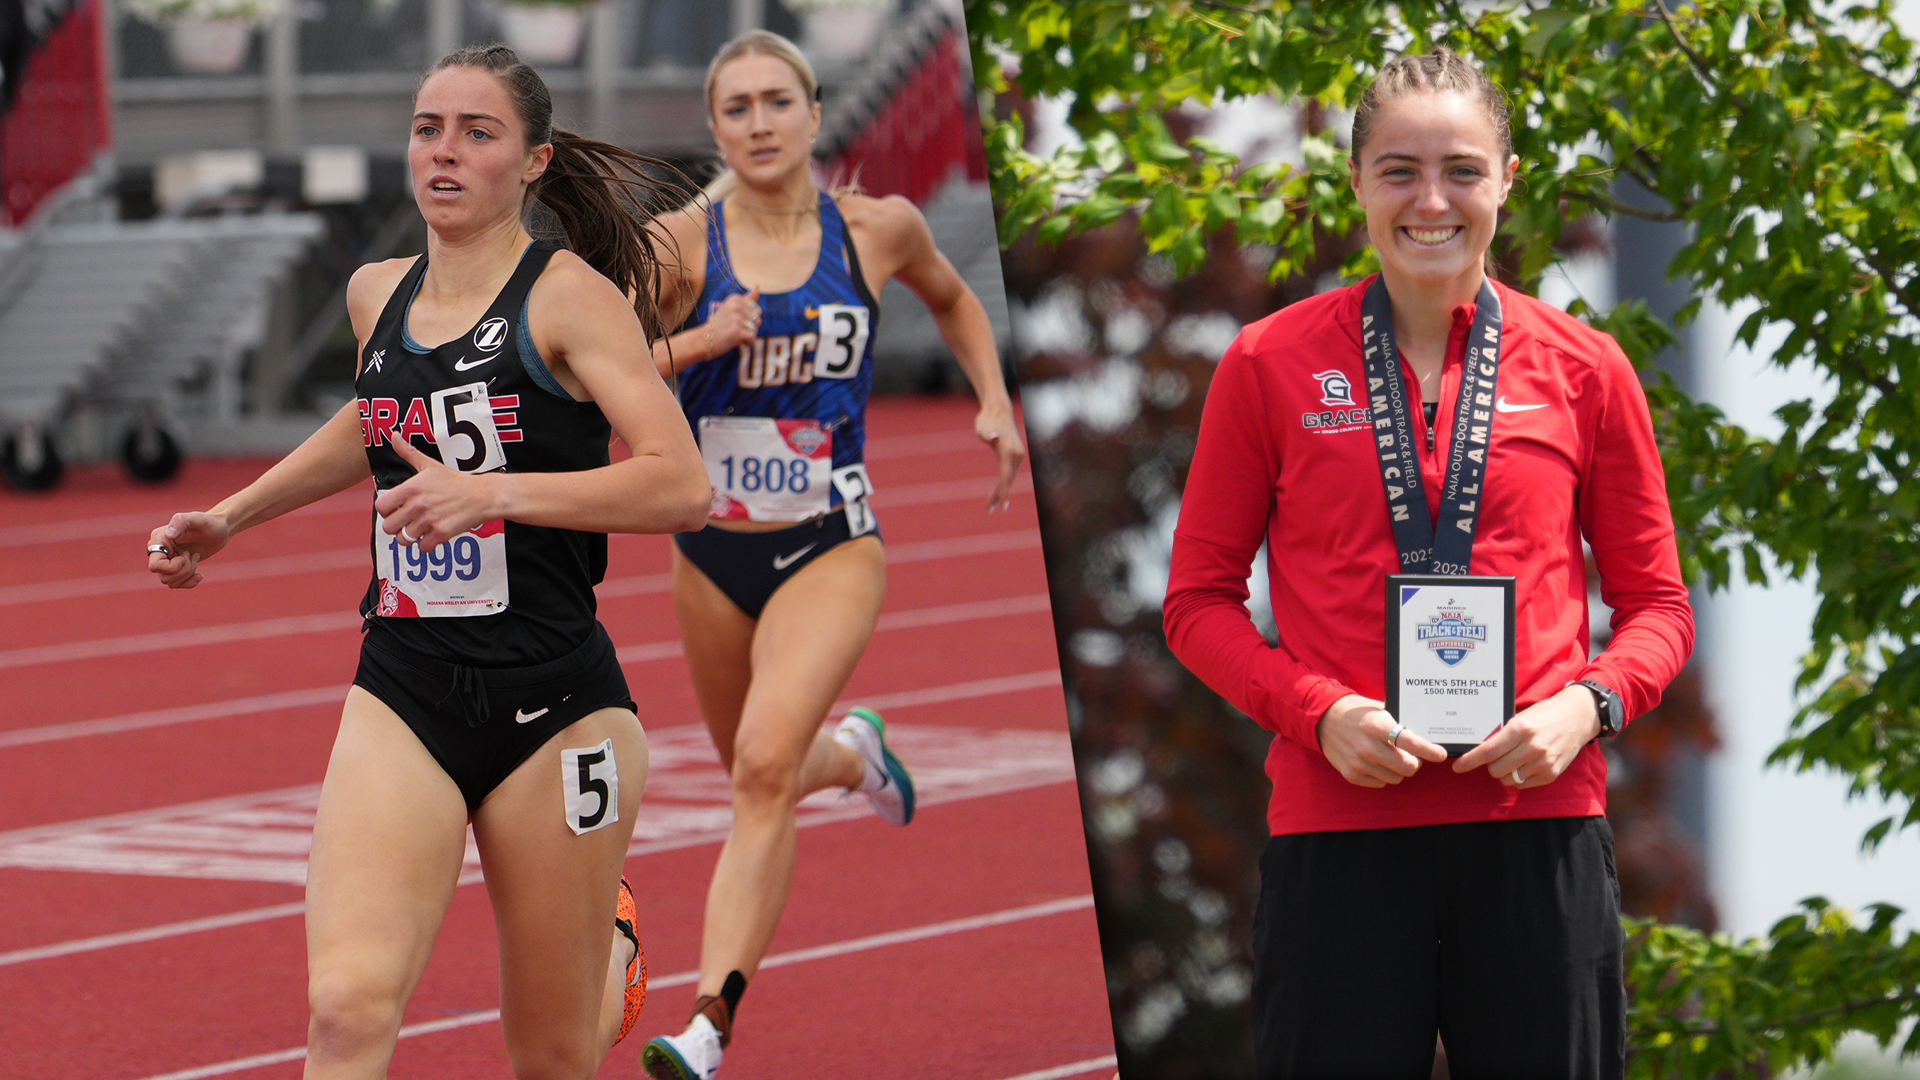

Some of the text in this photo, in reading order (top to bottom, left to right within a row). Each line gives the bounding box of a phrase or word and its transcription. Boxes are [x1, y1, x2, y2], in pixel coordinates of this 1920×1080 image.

[738, 332, 818, 389] UBC
[827, 312, 857, 373] 3
[357, 394, 523, 447] GRAE
[442, 390, 487, 472] 5
[1362, 315, 1410, 522] ALL-AMERICAN
[1380, 332, 1417, 488] NAIA OUTDOOR TRACK & FIELD
[1447, 346, 1479, 500] NAIA OUTDOOR TRACK & FIELD
[1456, 325, 1498, 534] ALL-AMERICAN
[720, 455, 809, 494] 1808
[388, 535, 481, 582] 1999
[1433, 561, 1467, 575] 2025
[1418, 625, 1452, 639] TRACK
[1456, 625, 1485, 640] FIELD
[1441, 612, 1462, 620] NAIA
[1405, 678, 1498, 688] WOMEN'S 5TH PLACE
[1446, 688, 1479, 696] METERS
[577, 748, 608, 829] 5
